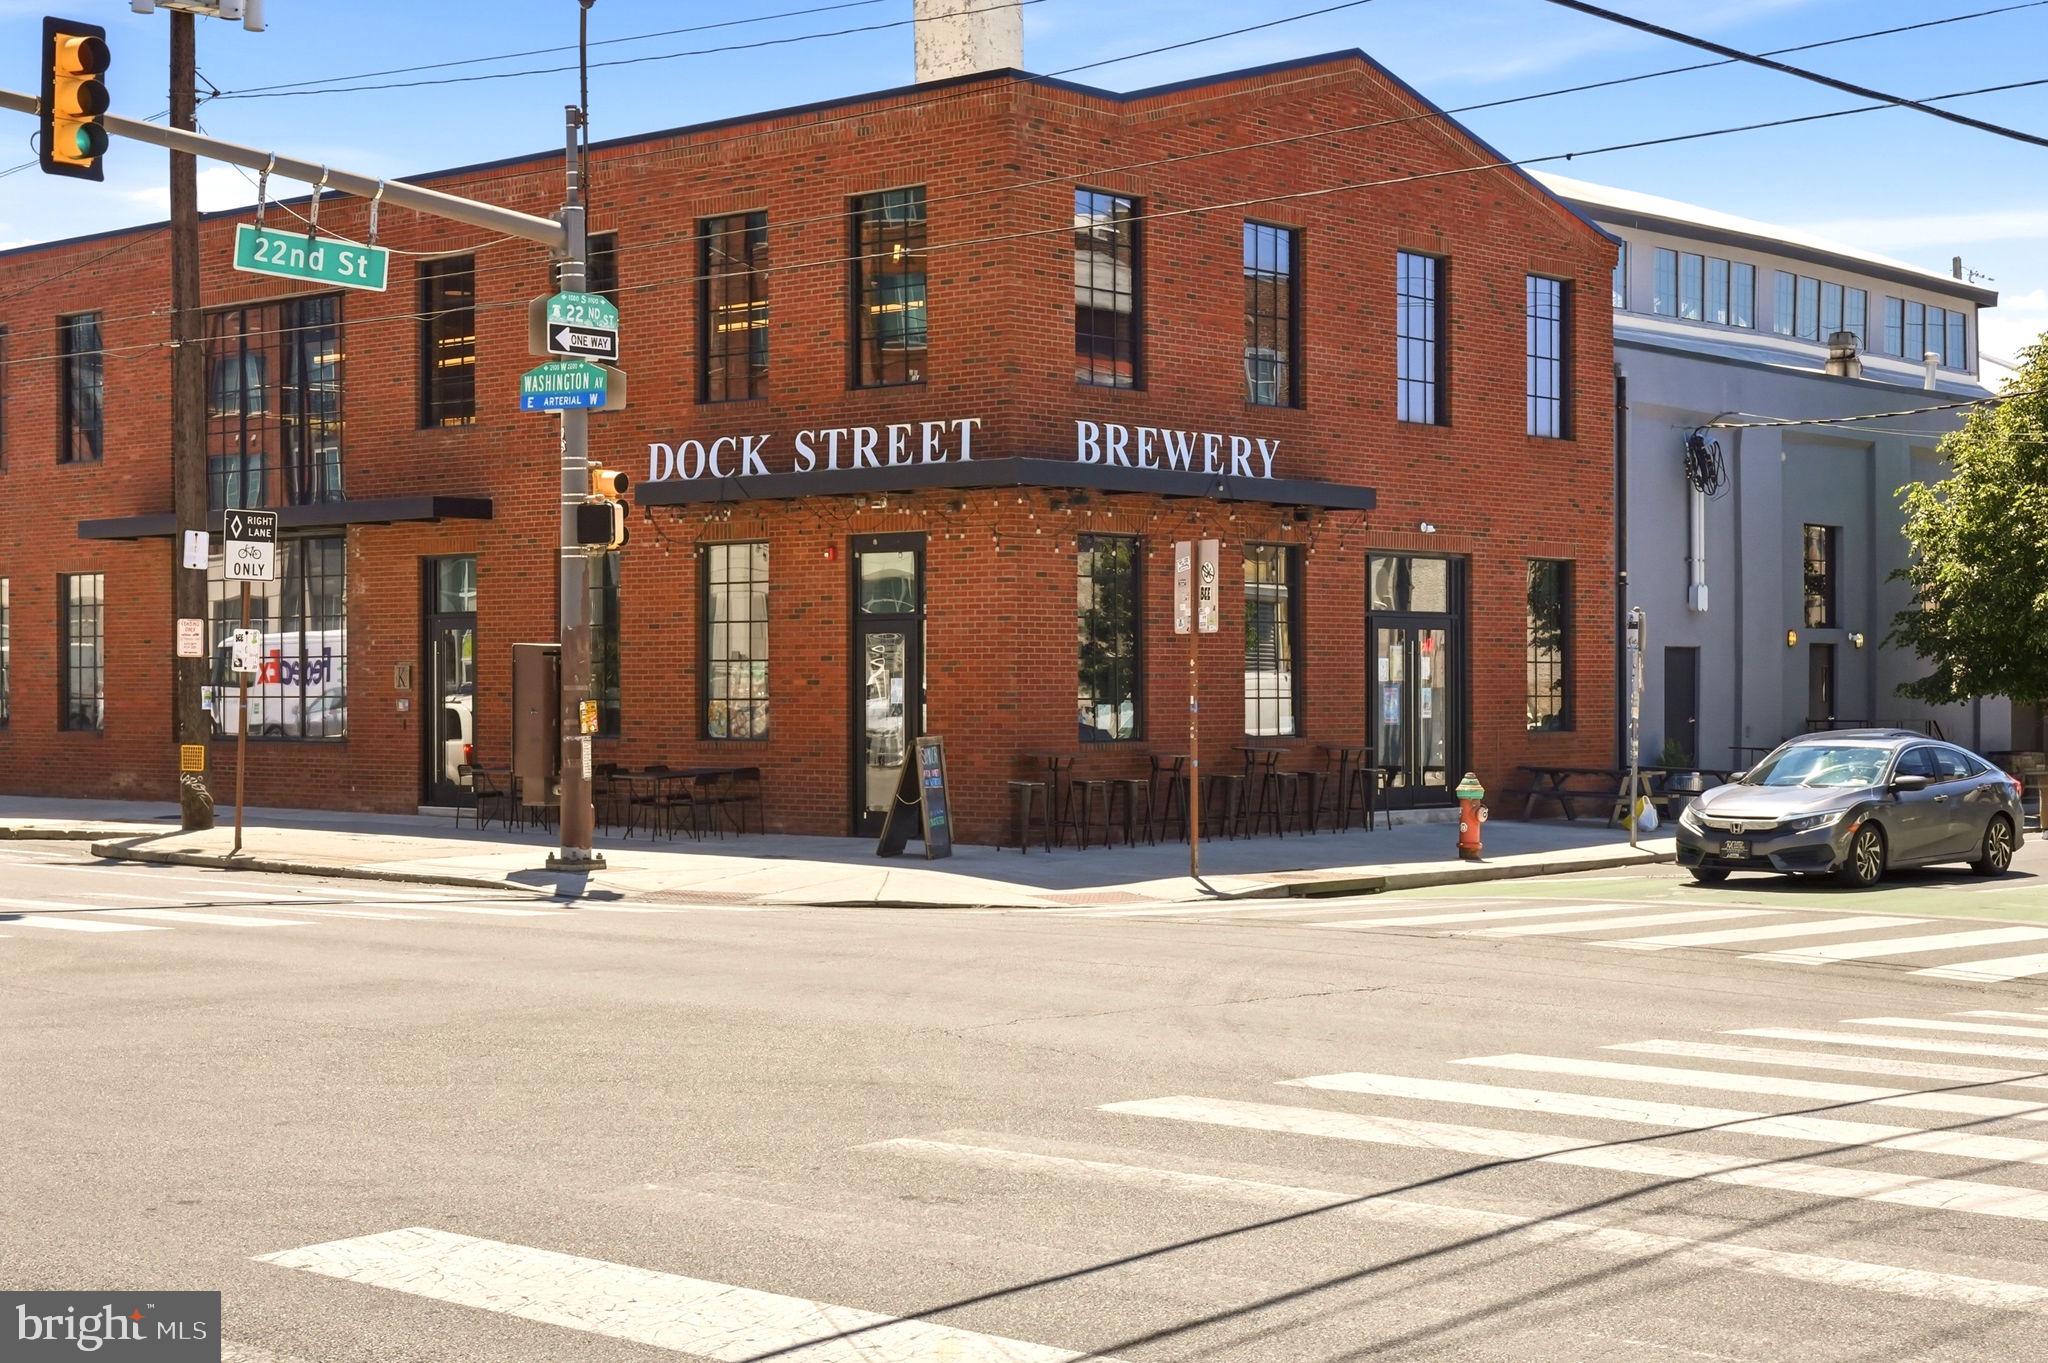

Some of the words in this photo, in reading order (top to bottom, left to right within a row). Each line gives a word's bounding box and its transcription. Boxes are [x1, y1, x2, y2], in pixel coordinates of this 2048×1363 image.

[254, 237, 324, 271] 22nd
[337, 251, 368, 278] St
[581, 295, 587, 304] S
[566, 304, 584, 323] 22
[588, 307, 600, 320] ND
[603, 315, 614, 326] ST
[570, 334, 588, 347] ONE
[590, 337, 609, 349] WAY
[524, 372, 590, 393] WASHINGTON
[594, 377, 604, 389] AV
[527, 397, 535, 408] E
[543, 396, 582, 406] ARTERIAL
[589, 393, 598, 405] W
[647, 433, 772, 482] DOCK
[794, 417, 982, 473] STREET
[1074, 419, 1281, 480] BREWERY
[247, 516, 274, 526] RIGHT
[248, 528, 272, 538] LANE
[233, 562, 265, 576] ONLY
